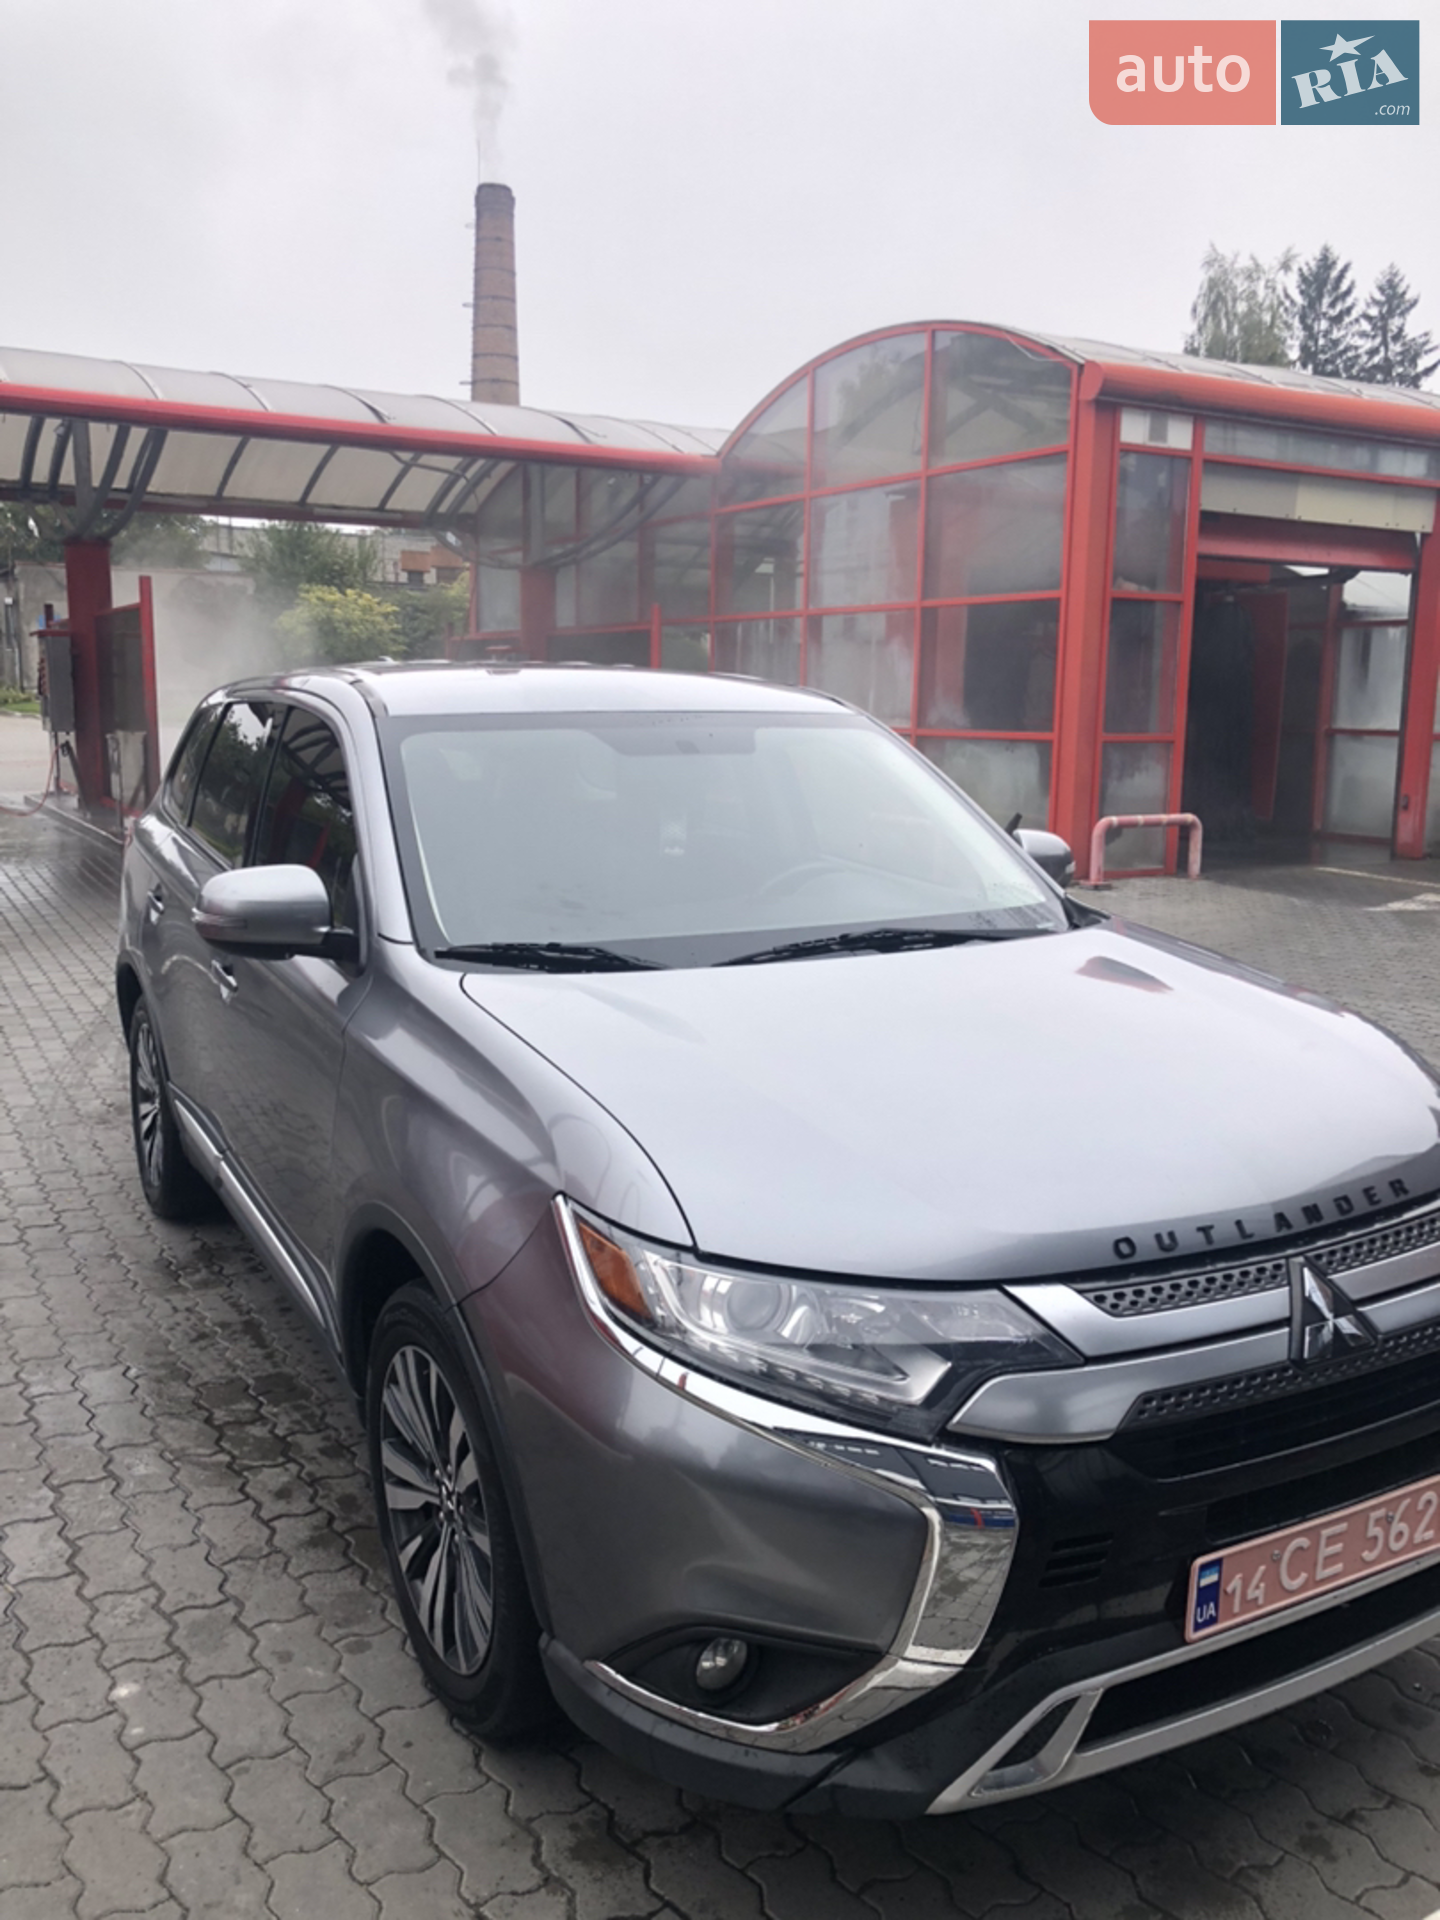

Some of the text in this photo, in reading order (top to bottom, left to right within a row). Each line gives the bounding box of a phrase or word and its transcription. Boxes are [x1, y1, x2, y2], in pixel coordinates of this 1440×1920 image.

[1112, 1177, 1410, 1260] OUTLANDER
[1223, 1490, 1438, 1614] 14 CE 562
[1195, 1601, 1217, 1623] UA
